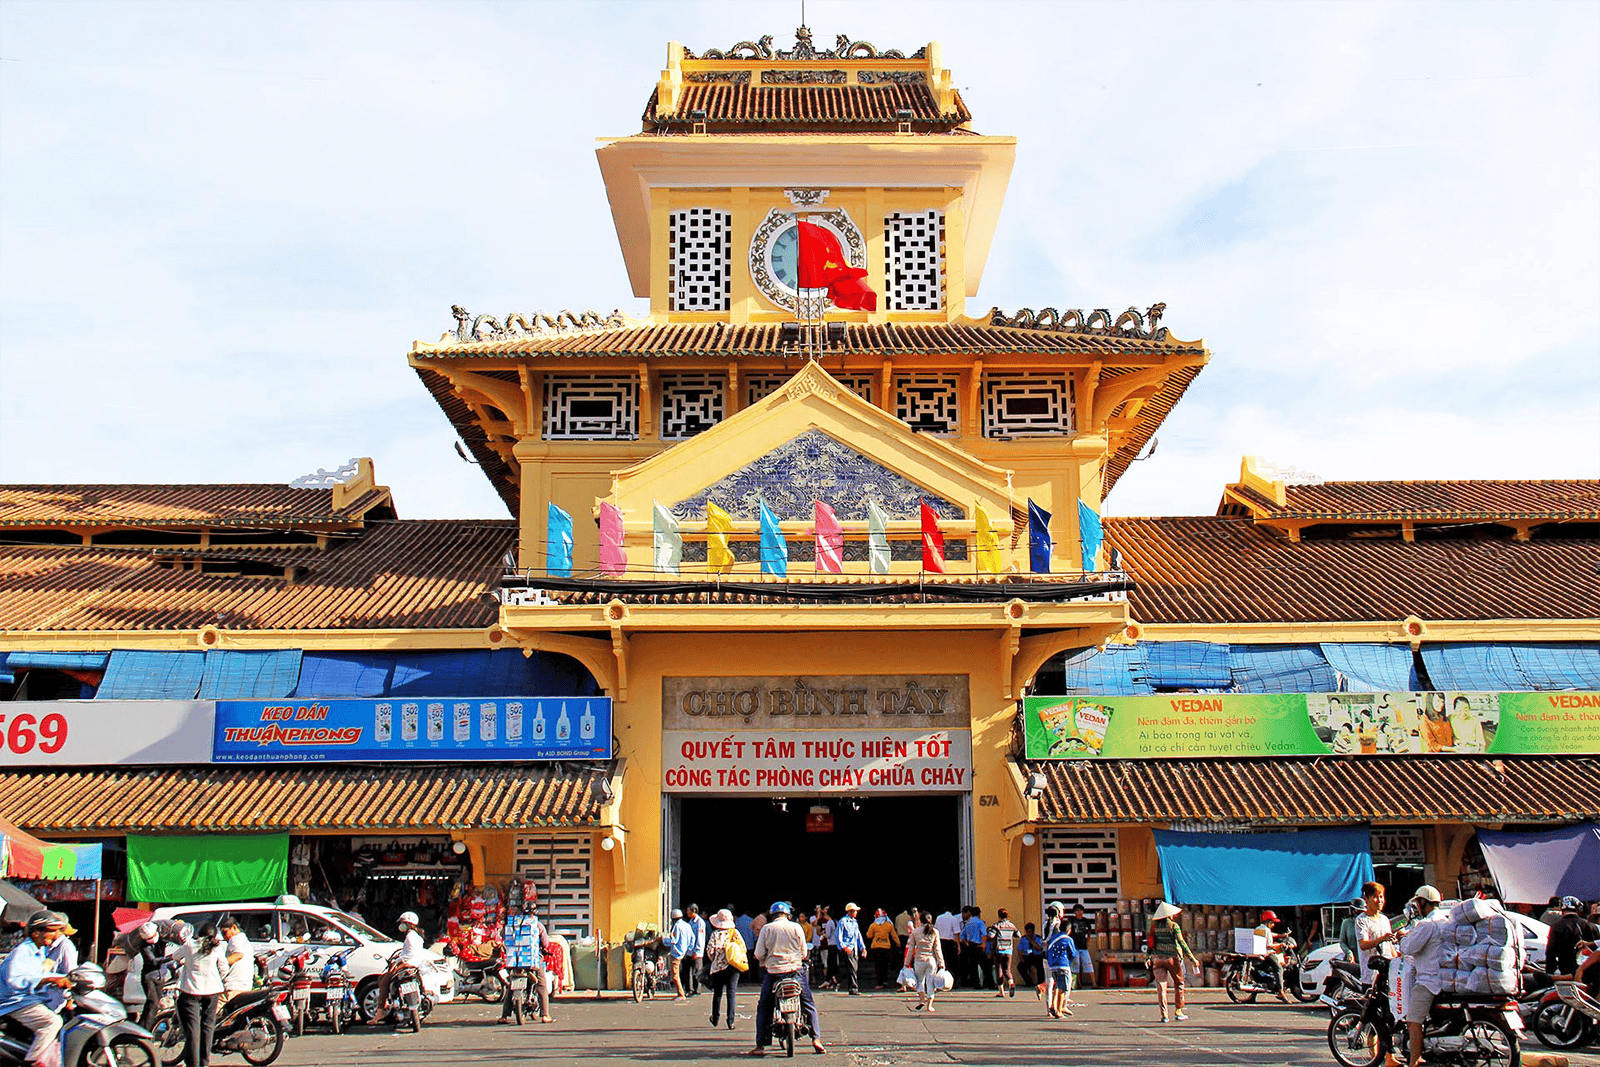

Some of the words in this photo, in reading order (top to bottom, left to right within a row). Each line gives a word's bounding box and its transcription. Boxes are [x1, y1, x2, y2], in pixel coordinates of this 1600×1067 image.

[682, 686, 760, 724] CHỢ
[769, 680, 867, 716] BÌNH
[877, 680, 949, 716] TÂY
[1170, 700, 1223, 712] VEDAN
[1548, 695, 1600, 708] VEDAN
[260, 706, 294, 720] KEO
[295, 703, 330, 720] DÁN
[1079, 711, 1107, 725] VEDAN
[0, 713, 68, 754] 69
[1139, 731, 1149, 740] Ai
[681, 734, 746, 761] QUYẾT
[752, 737, 795, 759] TÂM
[802, 738, 855, 762] THỰC
[861, 736, 907, 762] HIỆN
[914, 733, 952, 758] TỐT
[665, 764, 712, 787] CÔNG
[716, 764, 750, 787] TÁC
[756, 765, 814, 787] PHÒNG
[819, 765, 864, 786] CHÁY
[868, 763, 915, 786] CHỮA
[921, 763, 965, 786] CHÁY
[979, 795, 999, 807] 57A
